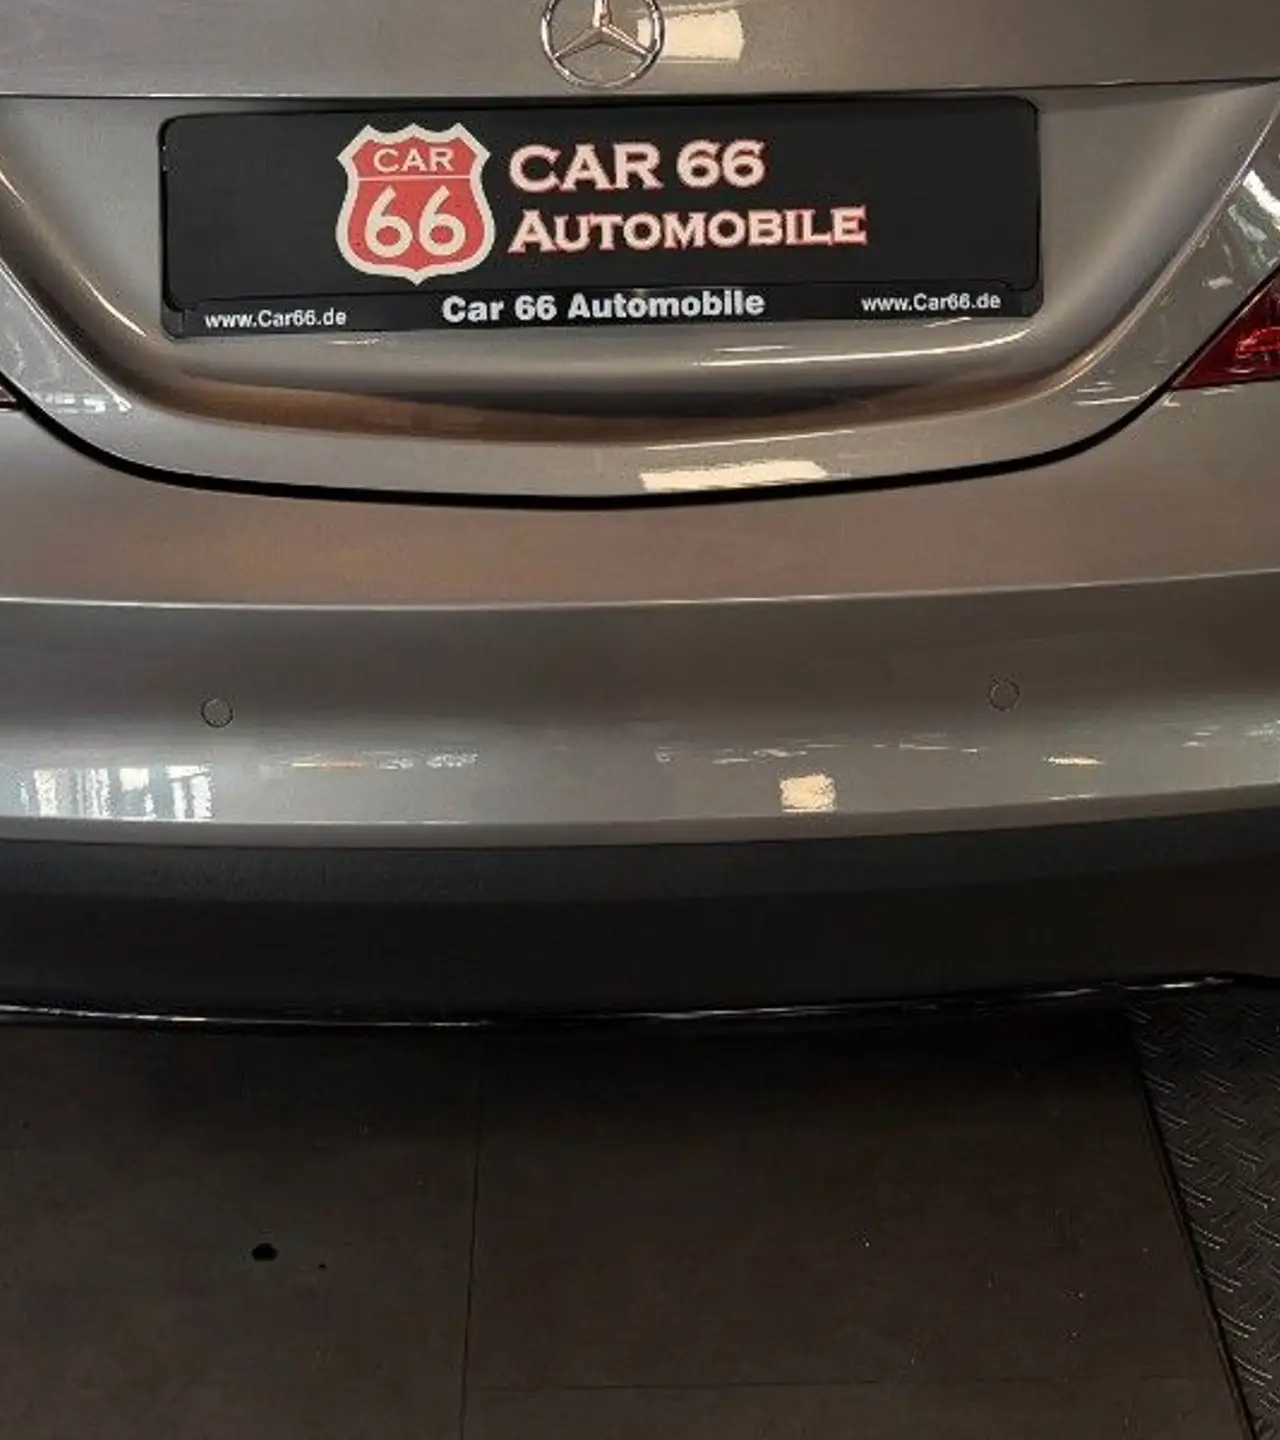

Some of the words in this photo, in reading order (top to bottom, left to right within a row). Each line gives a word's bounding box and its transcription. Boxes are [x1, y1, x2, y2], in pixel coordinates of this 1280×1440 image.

[373, 147, 454, 173] CAR
[508, 142, 663, 192] CAR
[675, 139, 766, 188] 66
[364, 184, 467, 258] 66
[507, 205, 868, 254] AUTOMOBILE
[204, 308, 347, 328] www.Car66.de
[442, 296, 504, 323] Car
[514, 294, 557, 321] 66
[567, 289, 765, 319] Automobile
[860, 293, 1002, 313] www.Car66.de
